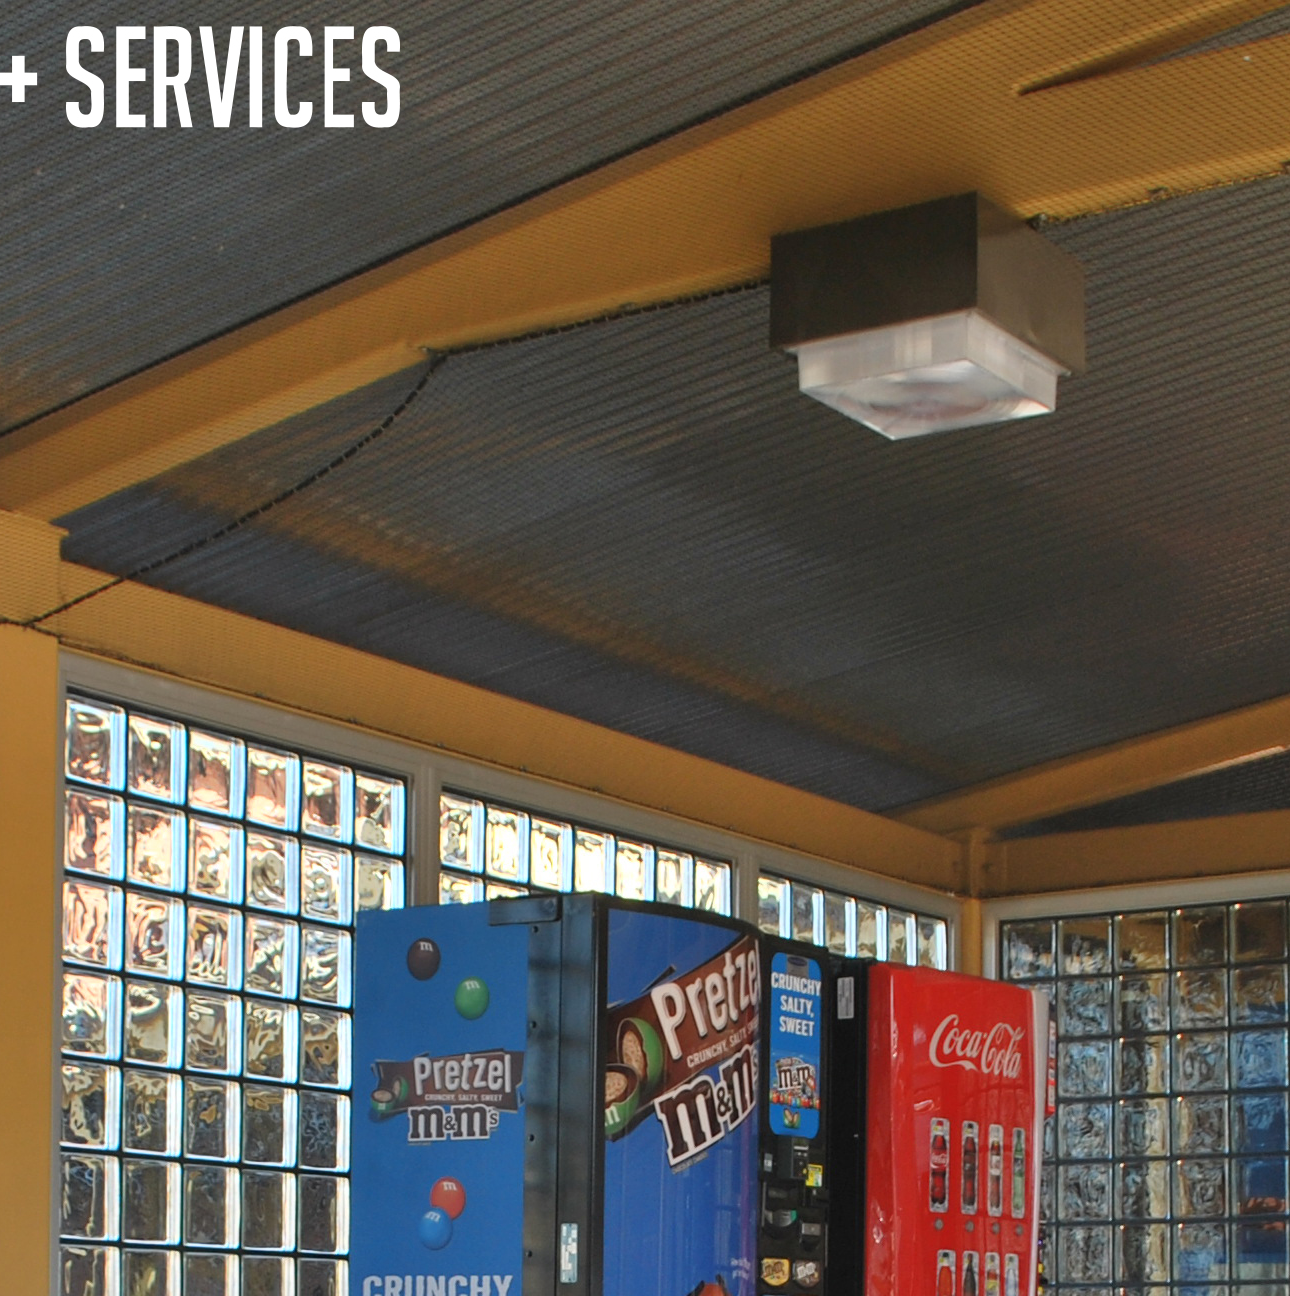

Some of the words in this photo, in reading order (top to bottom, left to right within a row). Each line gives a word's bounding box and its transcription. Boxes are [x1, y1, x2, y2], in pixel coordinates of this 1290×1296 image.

[780, 995, 814, 1018] SALTY,
[779, 1016, 815, 1037] SWEET
[929, 1014, 1026, 1079] Coca-Cola
[413, 1053, 512, 1096] Pretzel
[410, 1105, 498, 1139] m&m's
